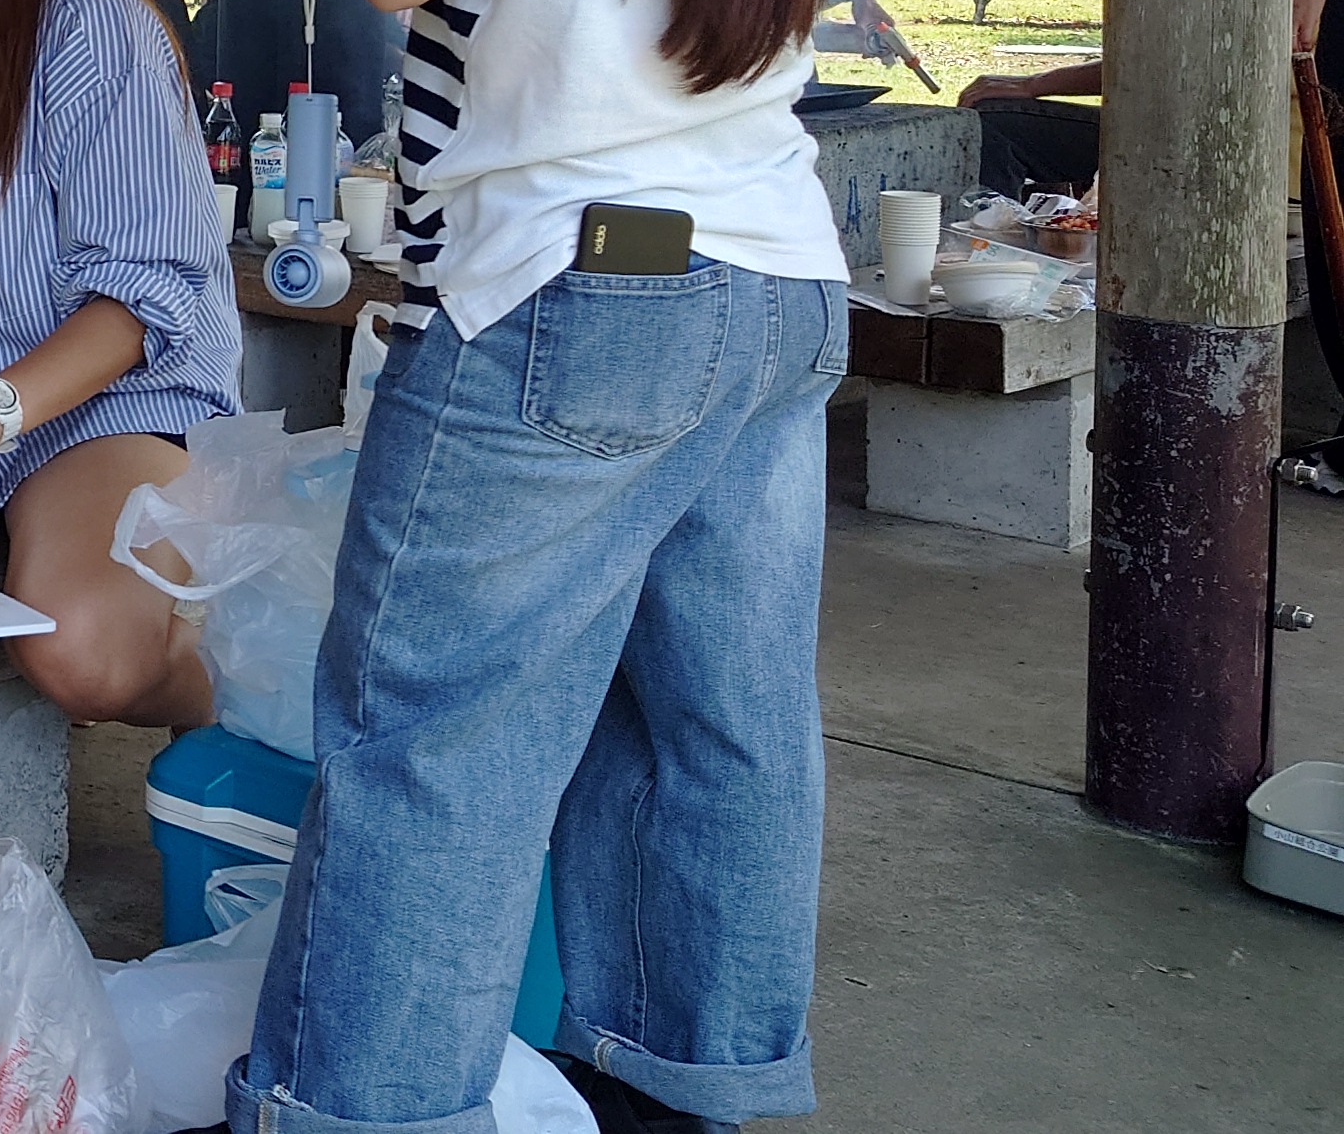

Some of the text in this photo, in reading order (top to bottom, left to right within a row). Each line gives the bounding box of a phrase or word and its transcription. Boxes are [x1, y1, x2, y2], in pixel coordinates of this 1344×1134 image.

[254, 158, 282, 166] カルピス
[254, 166, 282, 176] Water
[593, 224, 607, 255] oppo
